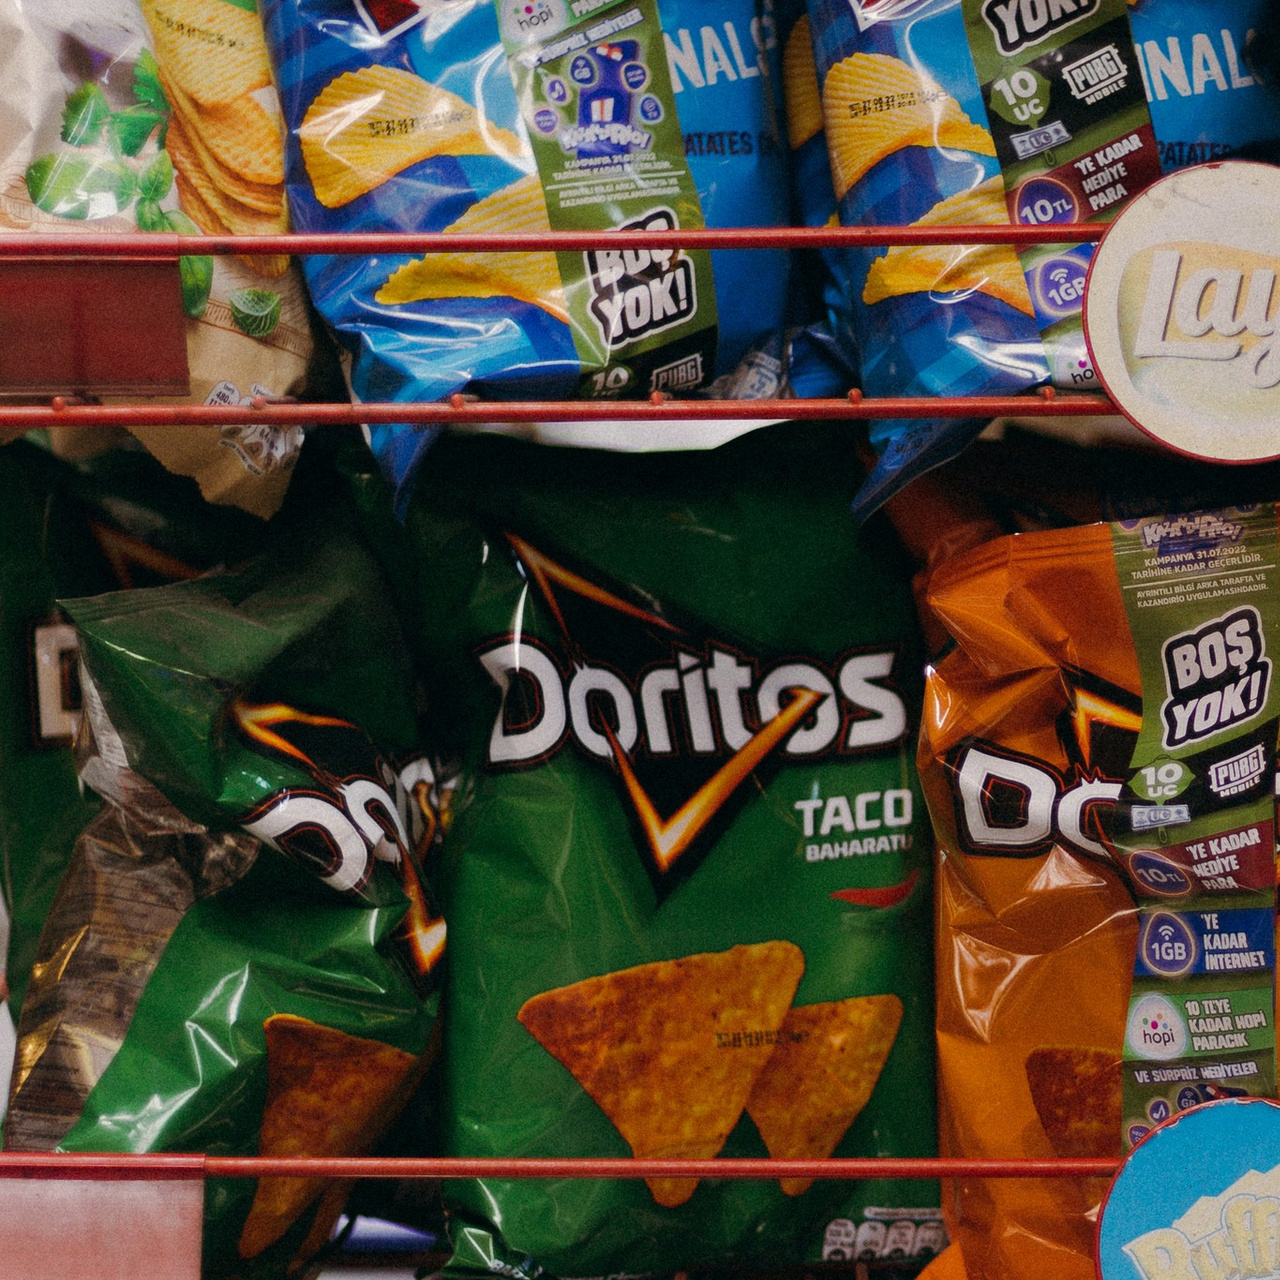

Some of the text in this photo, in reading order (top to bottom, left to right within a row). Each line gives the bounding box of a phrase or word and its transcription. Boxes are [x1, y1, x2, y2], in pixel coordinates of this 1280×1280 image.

[516, 4, 555, 32] hopi
[1070, 52, 1118, 92] PUBG
[992, 70, 1038, 107] 10
[1084, 78, 1128, 106] MOBILE
[1012, 98, 1045, 122] UC
[684, 132, 752, 157] ATATES
[1094, 133, 1143, 167] KADAR
[1081, 161, 1129, 195] HEDİYE
[1088, 183, 1129, 212] PARA
[597, 266, 689, 339] YOK!
[1131, 554, 1264, 580] TARİHİNE KADAR GEÇERLİDİR.
[1144, 544, 1247, 568] KAMPANYA 31.07.2022
[1136, 575, 1255, 599] AYRINTILI TARAFTA
[1185, 583, 1269, 602] UYGULAMASINDADIR.
[1171, 617, 1255, 690] BOŞ
[478, 637, 907, 764] Doritos
[1171, 669, 1262, 740] YOK!
[1140, 761, 1184, 786] 10
[1217, 753, 1260, 787] PUBG
[1147, 786, 1178, 798] UC
[1219, 775, 1262, 798] MOBILE
[794, 789, 913, 838] TACO
[1208, 827, 1262, 855] KADAR
[1192, 854, 1241, 878] HEDİYE
[1202, 875, 1239, 891] PARA
[1150, 942, 1187, 962] 1GB
[1202, 931, 1249, 951] KADAR
[1204, 950, 1266, 970] İNTERNET
[1184, 999, 1201, 1016] 10
[1187, 1010, 1268, 1034] KADAR HOPİ
[1142, 1027, 1176, 1047] hopi
[1192, 1034, 1249, 1052] PARACIK
[1133, 1061, 1259, 1084] VE SÜRPRİZ HEDİYELER
